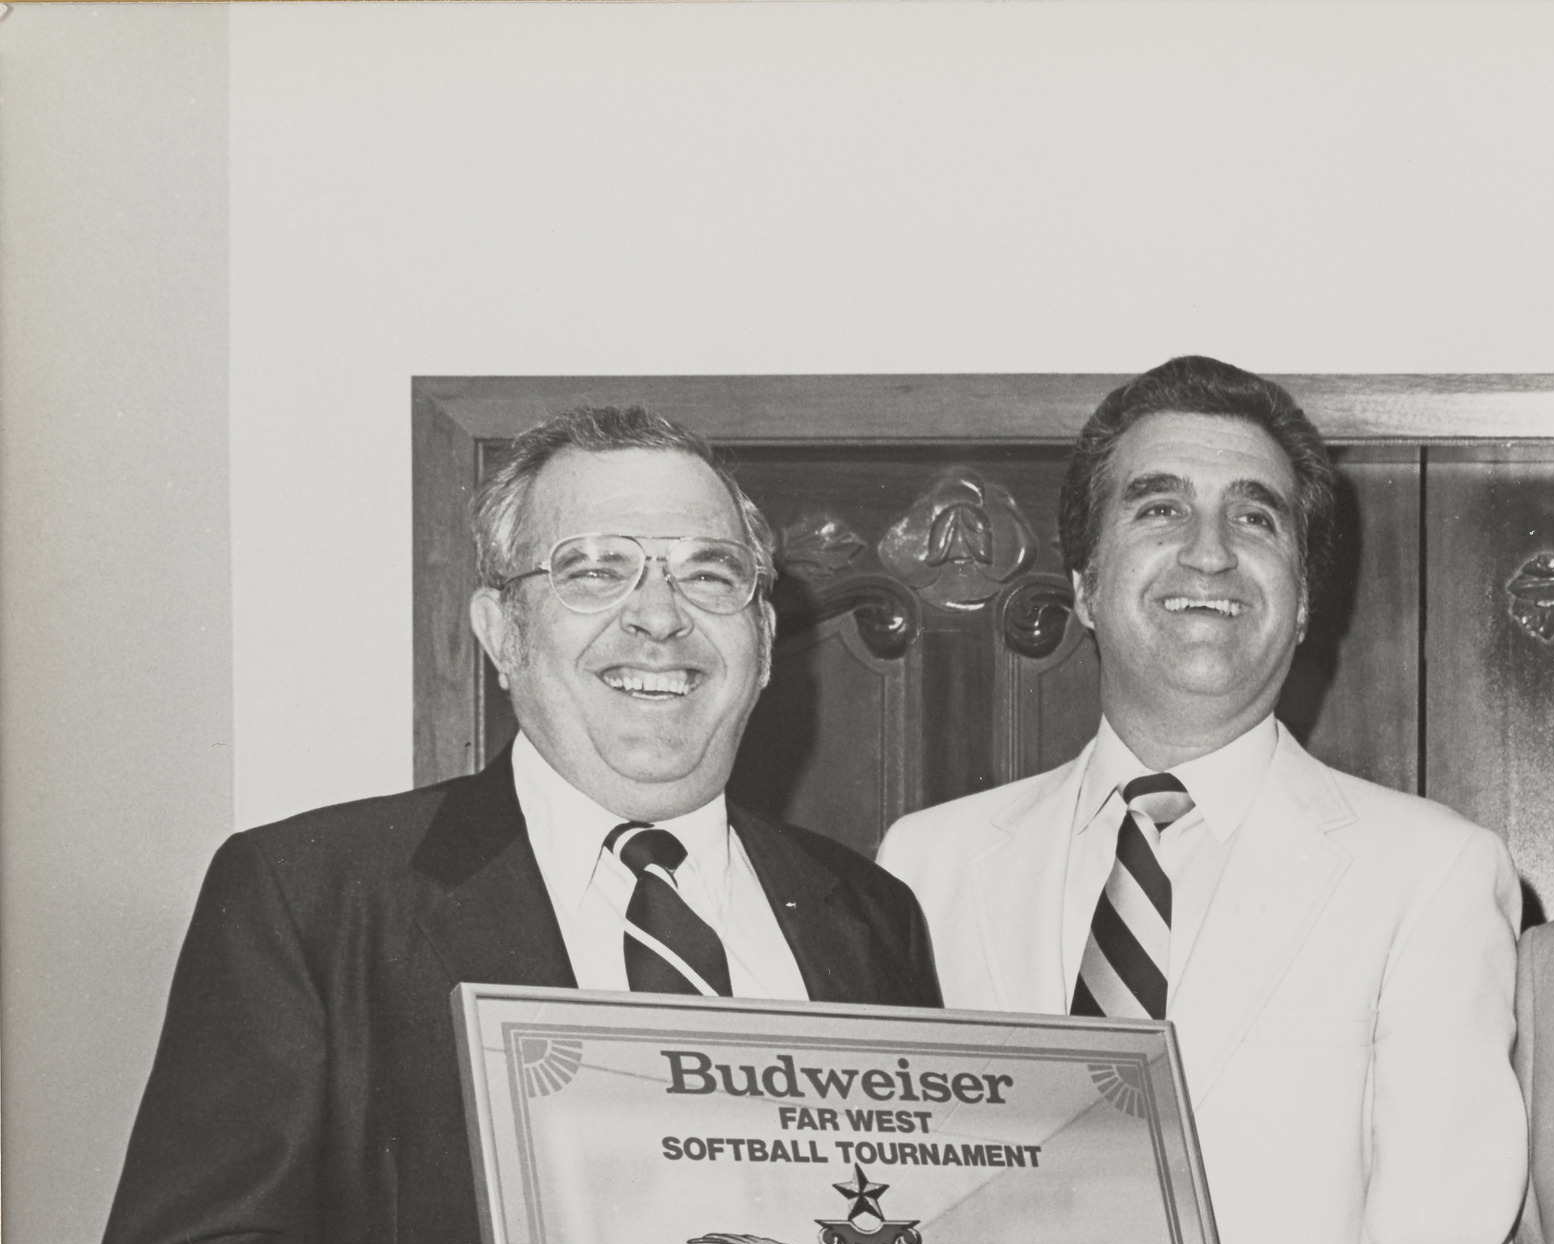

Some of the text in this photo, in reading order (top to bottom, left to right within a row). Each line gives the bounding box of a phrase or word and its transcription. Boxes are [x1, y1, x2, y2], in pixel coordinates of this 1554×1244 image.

[660, 1049, 1014, 1105] Budweiser
[779, 1106, 933, 1135] FAR WEST
[661, 1136, 1042, 1168] SOFTBALL TOURNAMENT
